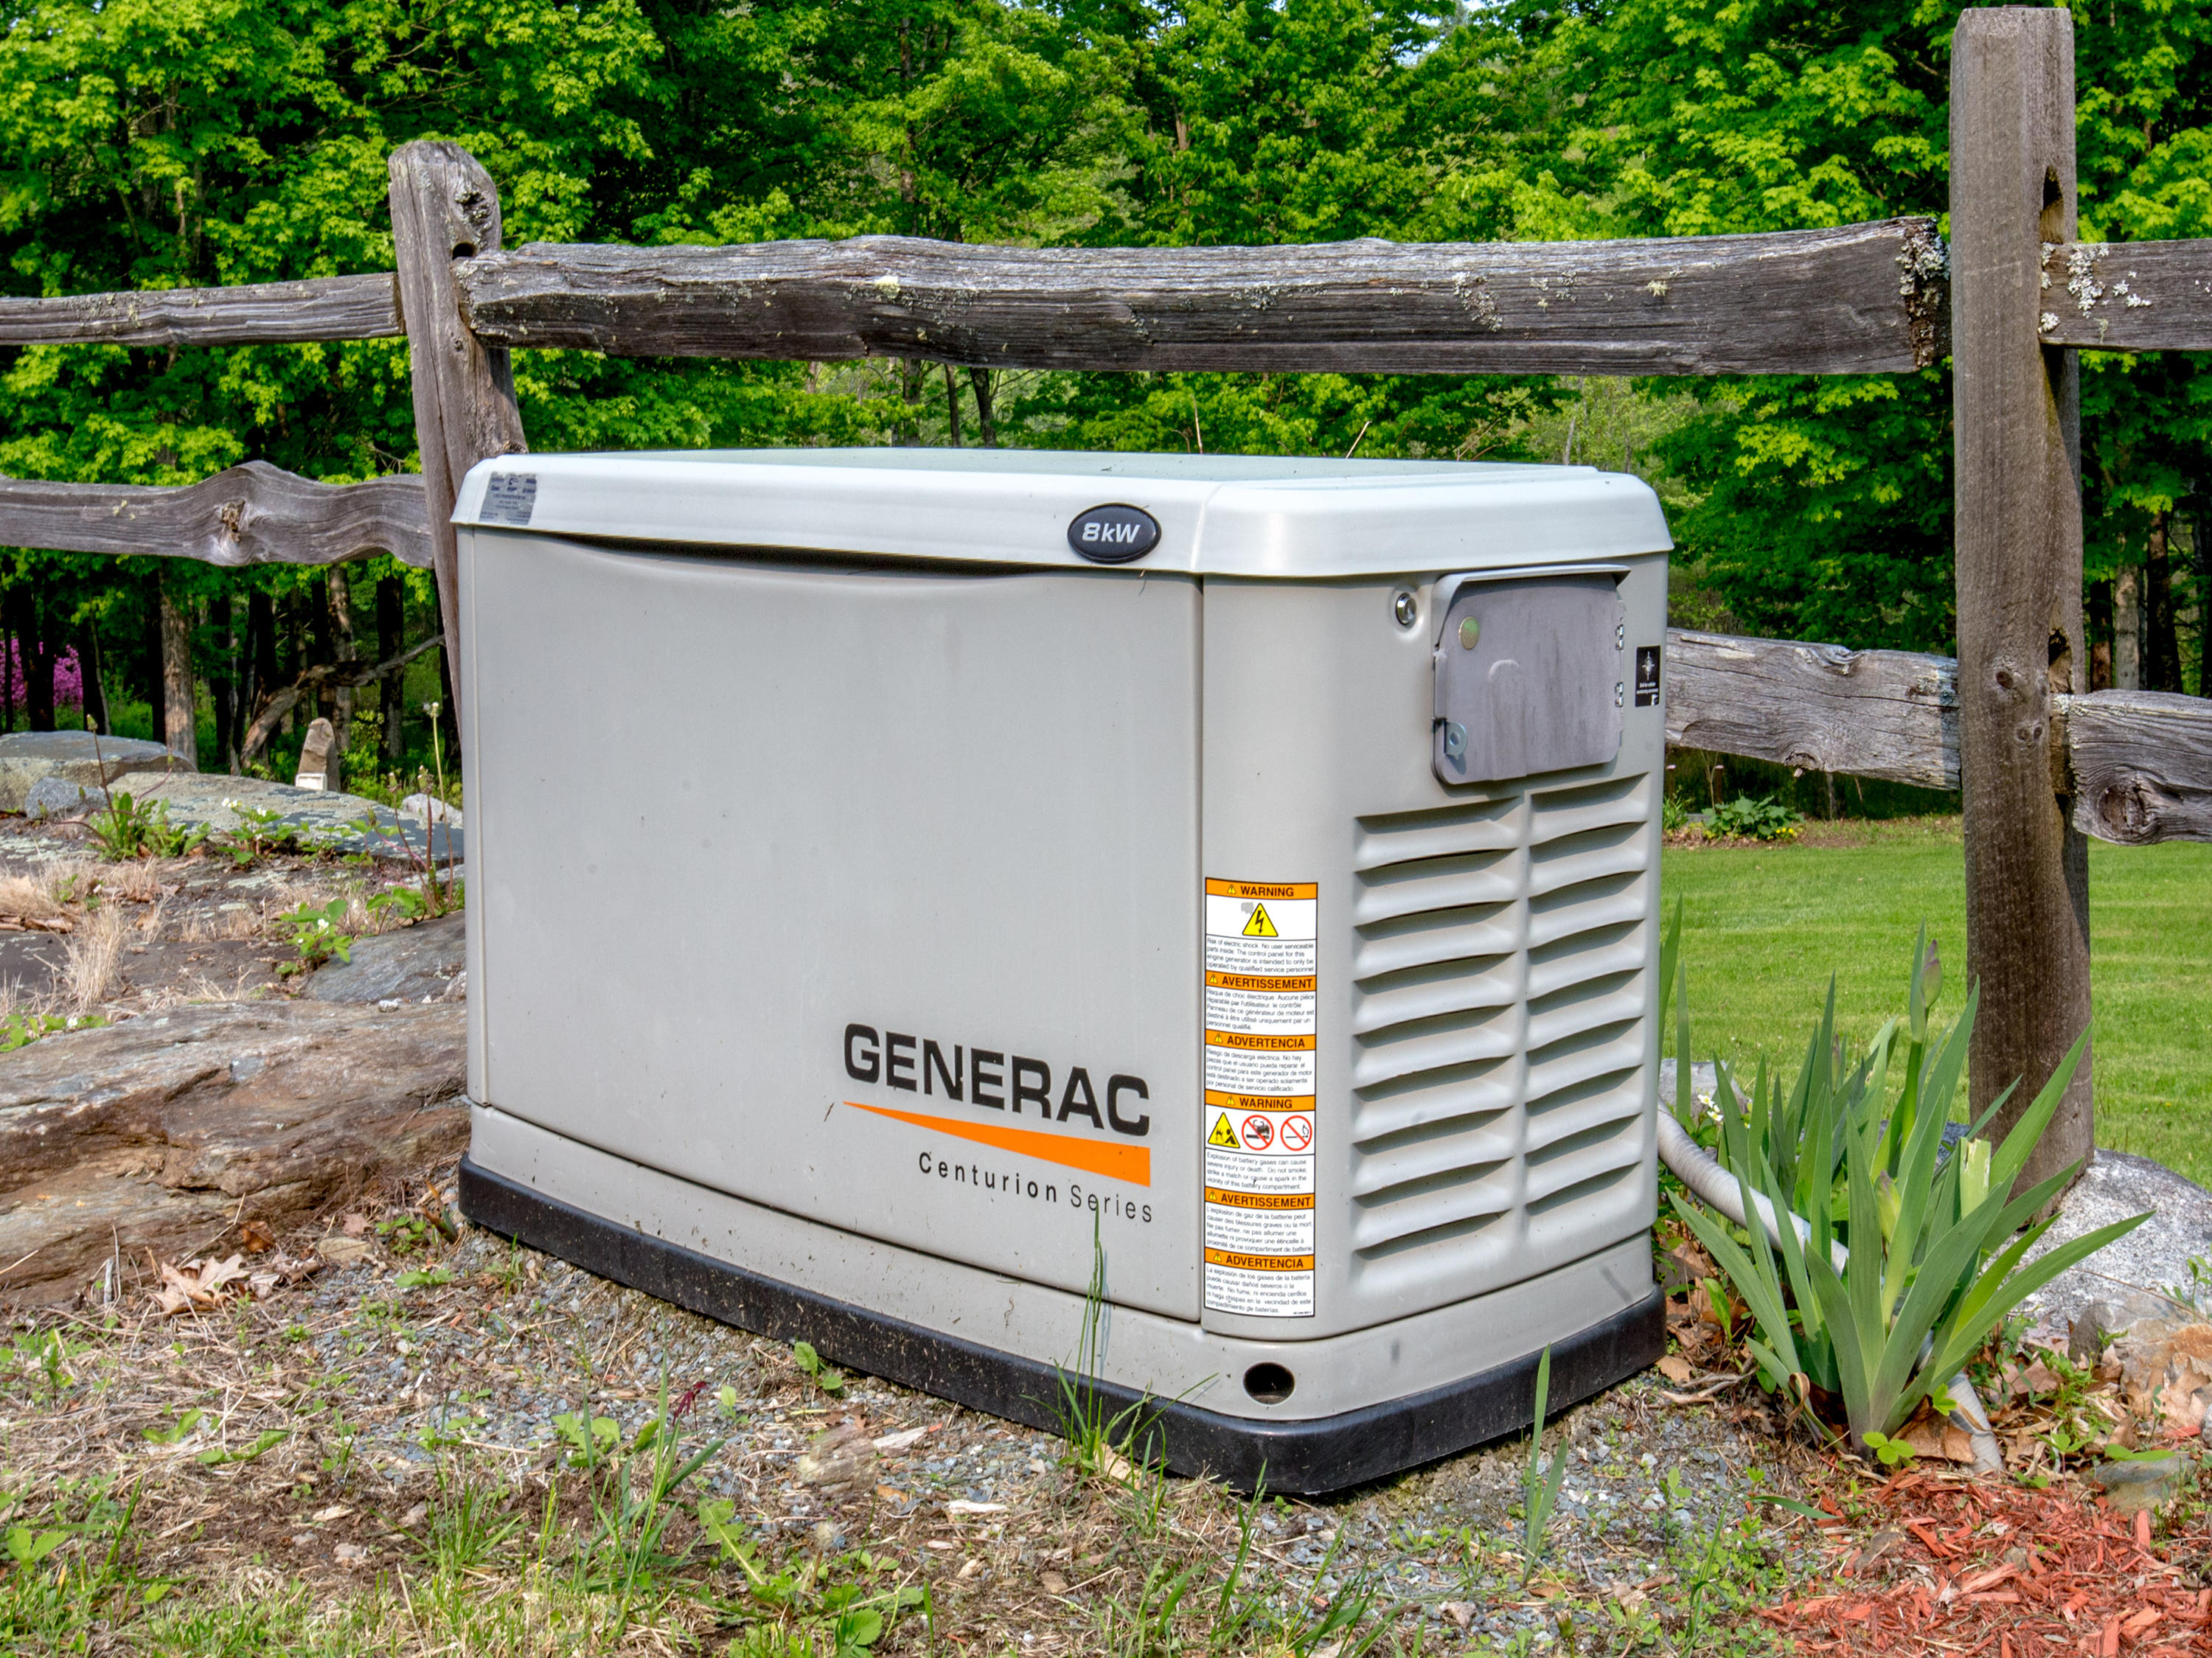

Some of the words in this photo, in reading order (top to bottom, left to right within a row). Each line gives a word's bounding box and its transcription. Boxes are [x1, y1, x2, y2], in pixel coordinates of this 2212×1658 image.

[1082, 522, 1141, 543] 8kW
[1240, 885, 1294, 896] WARNING
[1222, 976, 1312, 989] AVERTISSEMENT
[1227, 1035, 1305, 1048] ADVERTENCIA
[844, 1023, 1150, 1137] GENERAC
[1239, 1097, 1293, 1109] WARNING
[919, 1151, 1057, 1203] Centurion
[1070, 1184, 1153, 1224] Series
[1221, 1193, 1311, 1207] AVERTISSEMENT
[1226, 1255, 1304, 1268] ADVERTENCIA
